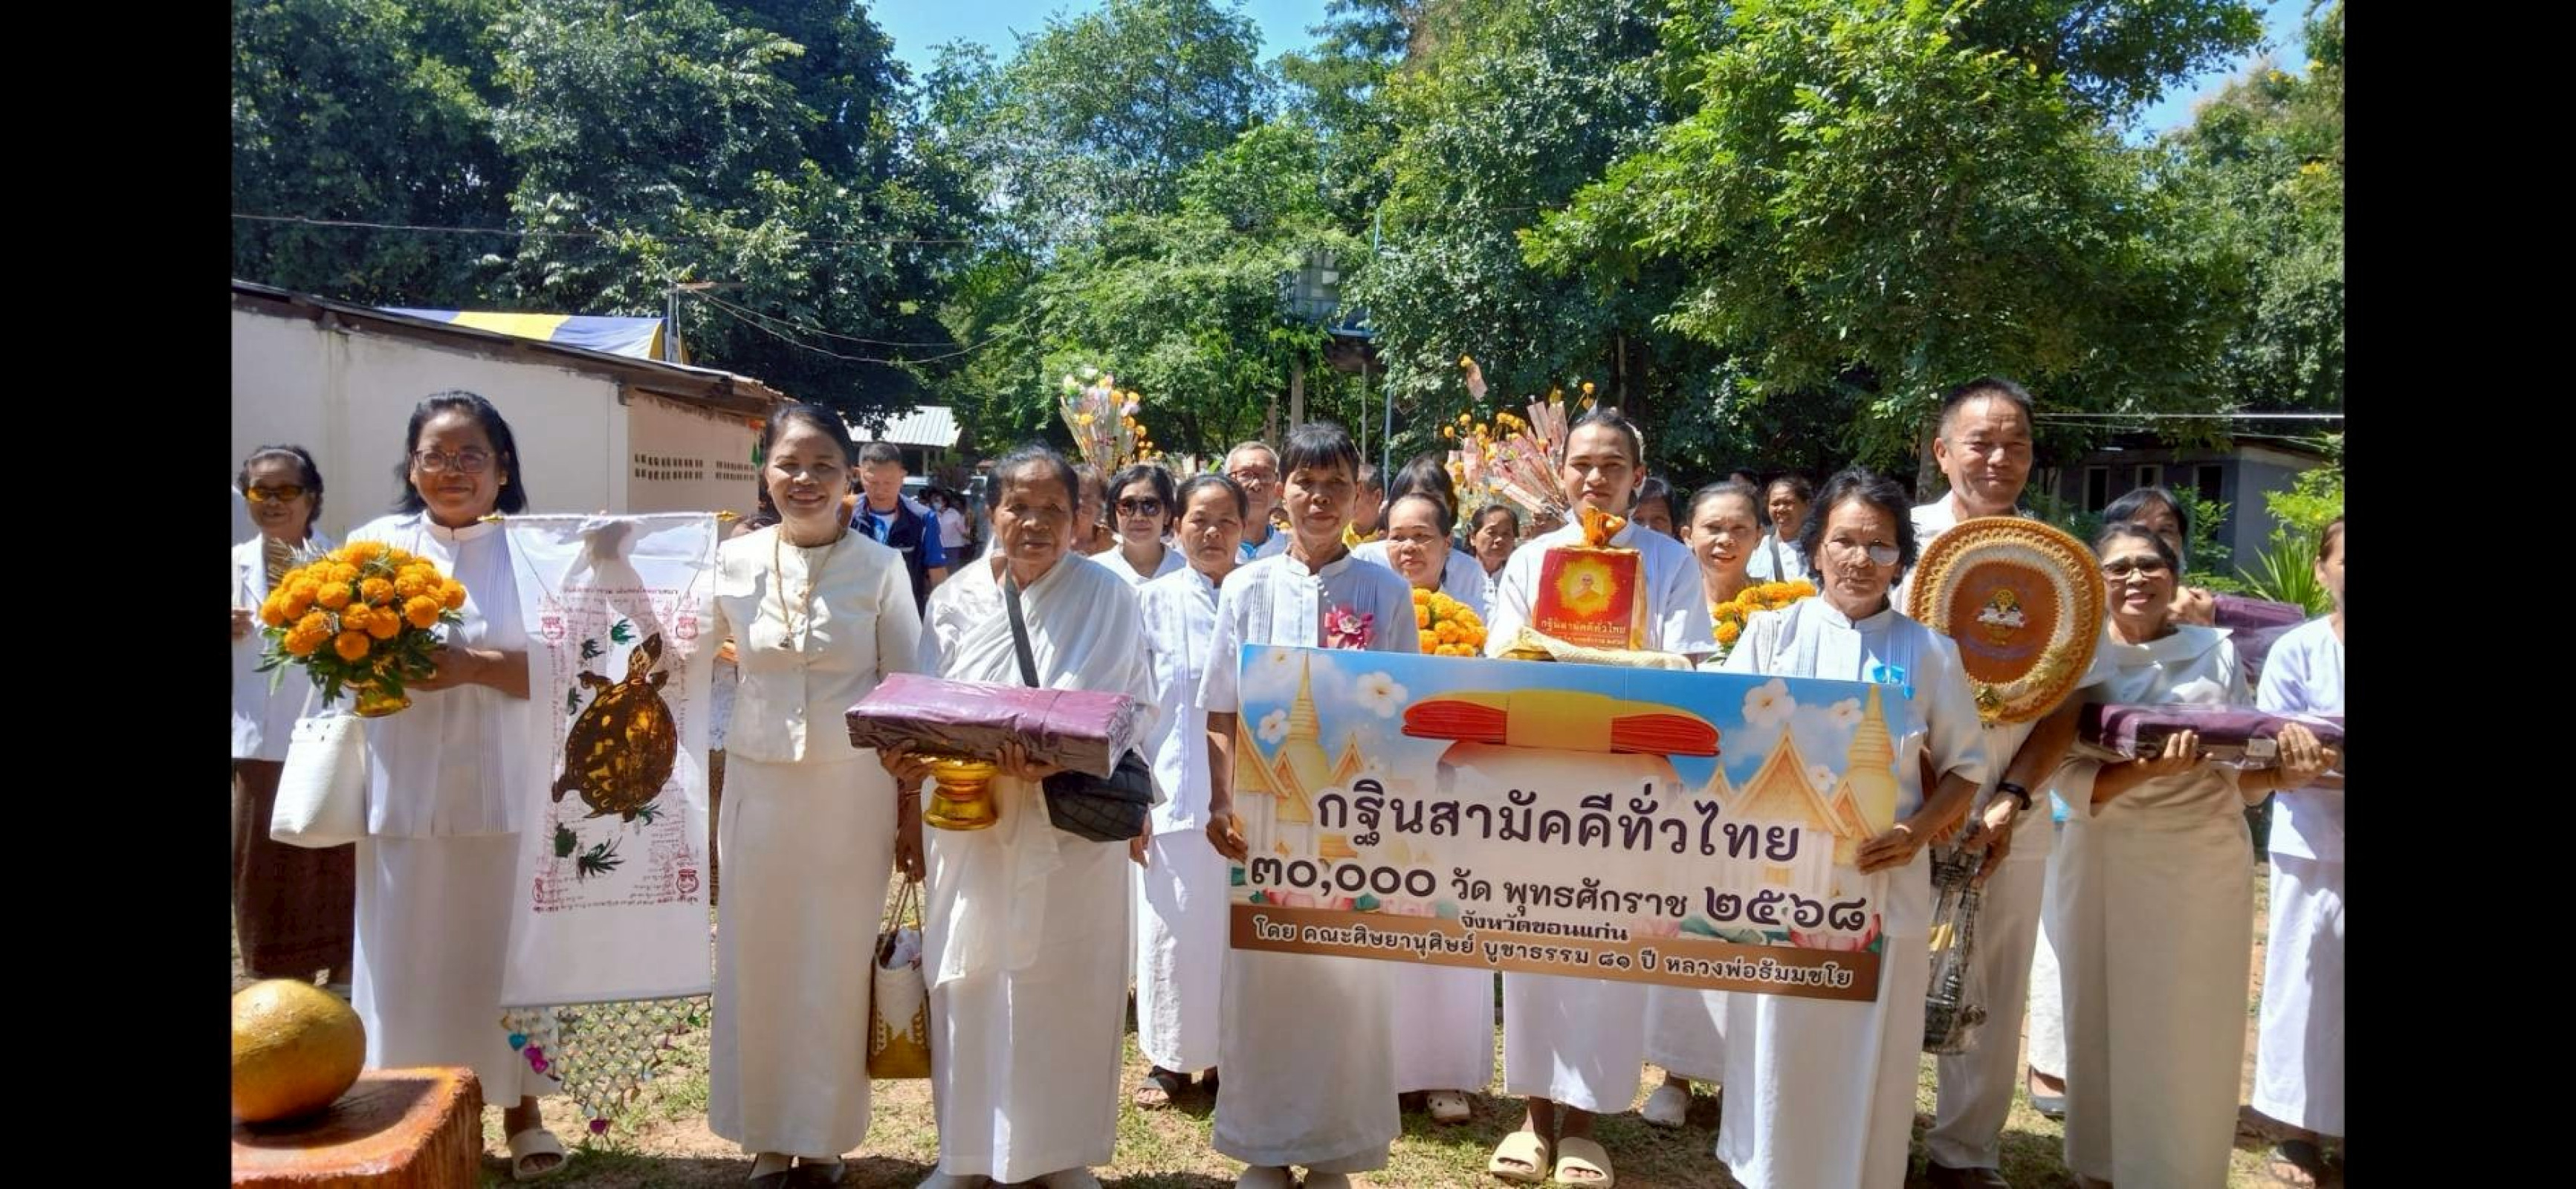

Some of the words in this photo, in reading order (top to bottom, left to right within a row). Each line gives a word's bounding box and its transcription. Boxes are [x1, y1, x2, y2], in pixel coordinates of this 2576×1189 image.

[1318, 779, 1799, 862] กฐินสามัคคีทั่วไทย
[1251, 857, 1437, 897] ๓๐,๐๐๐
[1451, 867, 1492, 901] วัด
[1504, 878, 1688, 917] พุทธศักราช
[1704, 887, 1867, 931] ๒๕๖๘
[1461, 910, 1628, 942] จังหวัดขอนแก่น
[1255, 917, 1295, 940] โดย
[1304, 926, 1474, 956] คณะศิษยานุศิษย์
[1484, 941, 1589, 964] บูชาธรรม
[1599, 953, 1631, 968] ๘๑
[1641, 950, 1656, 969] ปี
[1666, 956, 1852, 986] หลวงพ่อธัมมชโย
